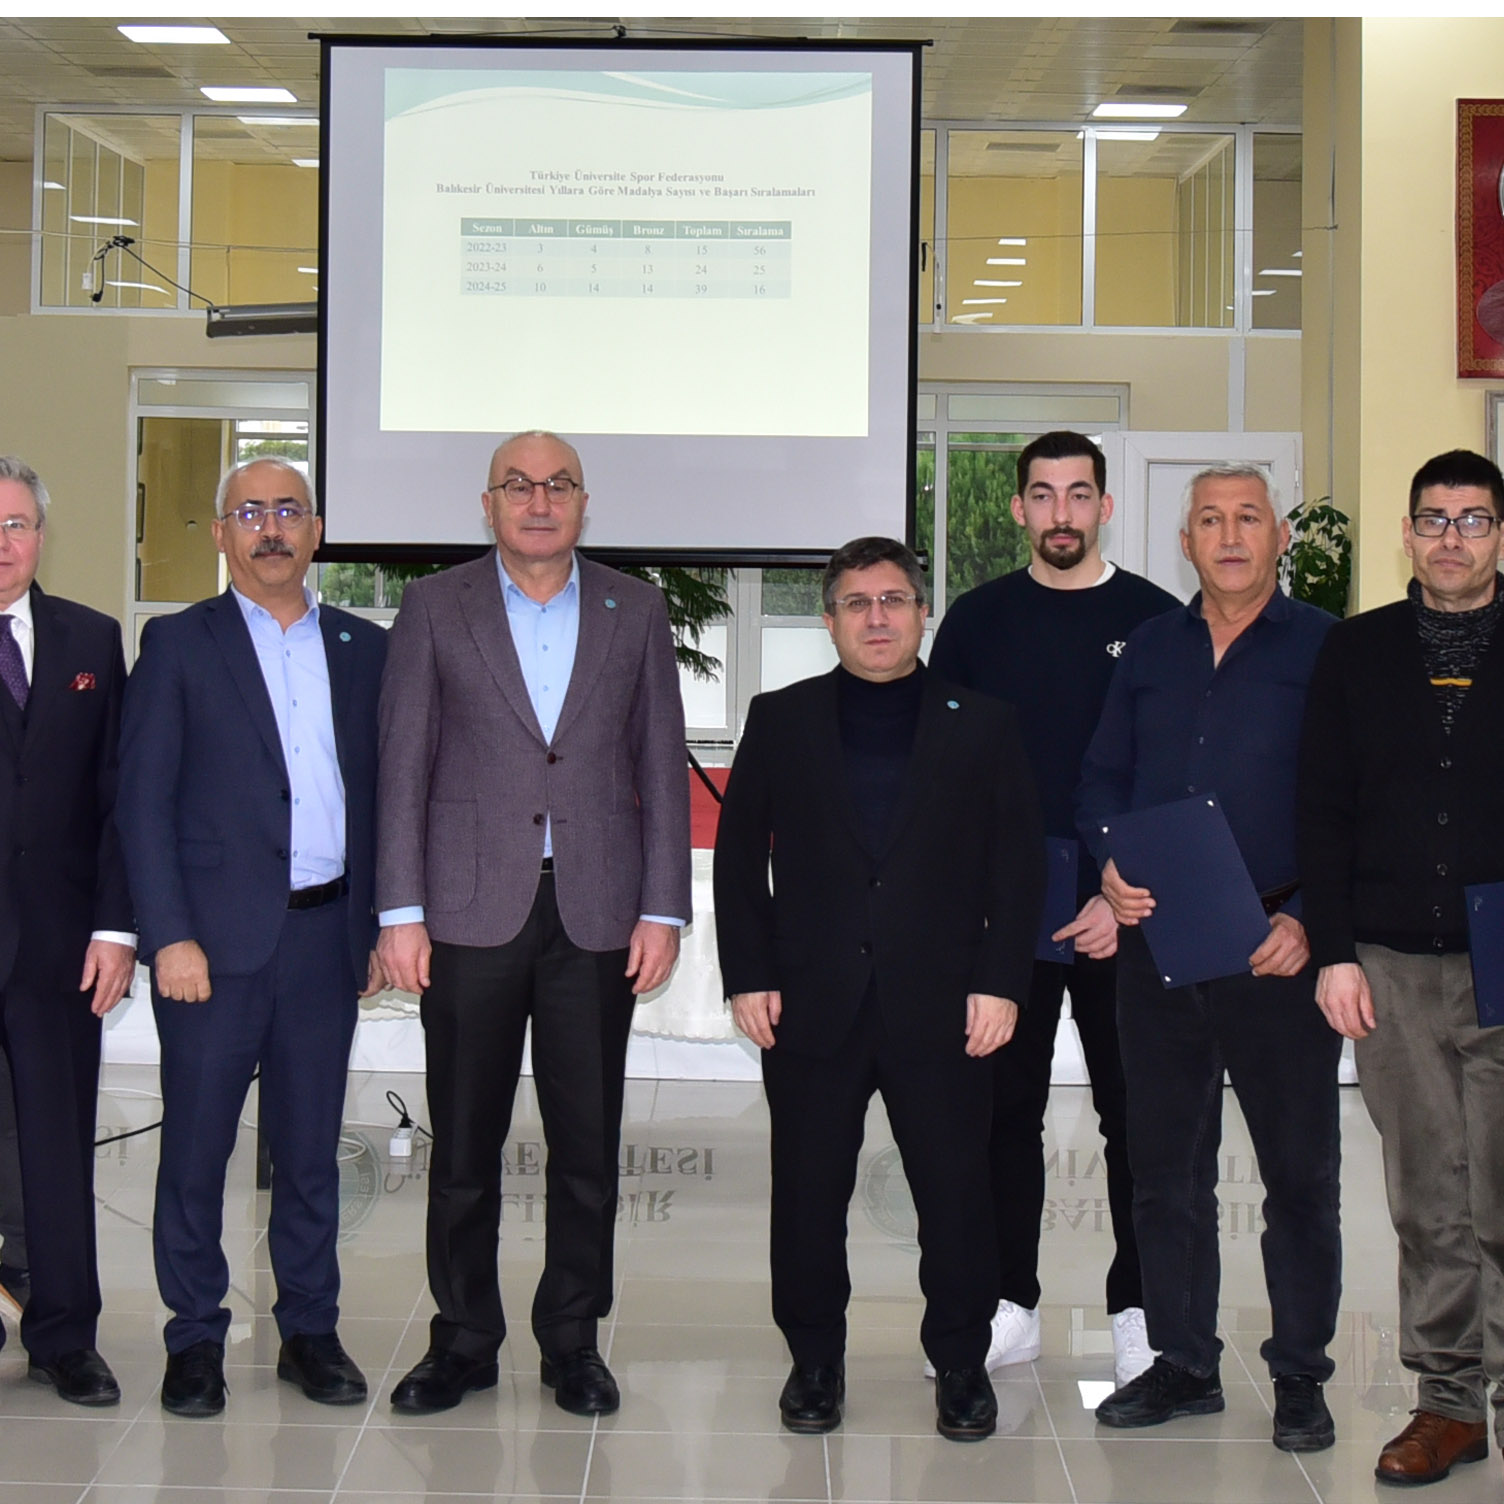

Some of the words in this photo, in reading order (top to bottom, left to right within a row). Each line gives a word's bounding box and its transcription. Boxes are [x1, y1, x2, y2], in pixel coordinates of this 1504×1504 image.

[529, 170, 570, 182] Türkiye
[574, 169, 626, 181] Üniversite
[630, 172, 655, 183] Spor
[658, 172, 724, 184] Federasyonu
[486, 182, 545, 195] Üniversitesi
[588, 185, 615, 196] Göre
[617, 186, 662, 198] Madalya
[699, 189, 711, 197] ve
[472, 223, 502, 233] Sezon
[528, 224, 554, 234] Altın
[576, 224, 614, 236] Gümüş
[633, 225, 665, 235] Bronz
[683, 225, 722, 237] Toplam
[736, 226, 784, 236] Sıralama
[466, 242, 507, 253] 2022-23
[537, 243, 544, 253] 3
[644, 245, 651, 255] 8
[696, 245, 708, 255] 15
[753, 245, 766, 256] 56
[466, 261, 507, 272] 2023-24
[537, 262, 544, 273] 6
[591, 263, 597, 273] 5
[642, 264, 654, 275] 13
[695, 264, 707, 275] 24
[753, 265, 766, 275] 25
[465, 281, 507, 291] 2024-25
[535, 282, 546, 292] 10
[588, 283, 600, 293] 14
[642, 283, 653, 294] 14
[695, 284, 707, 295] 39
[754, 284, 766, 295] 16
